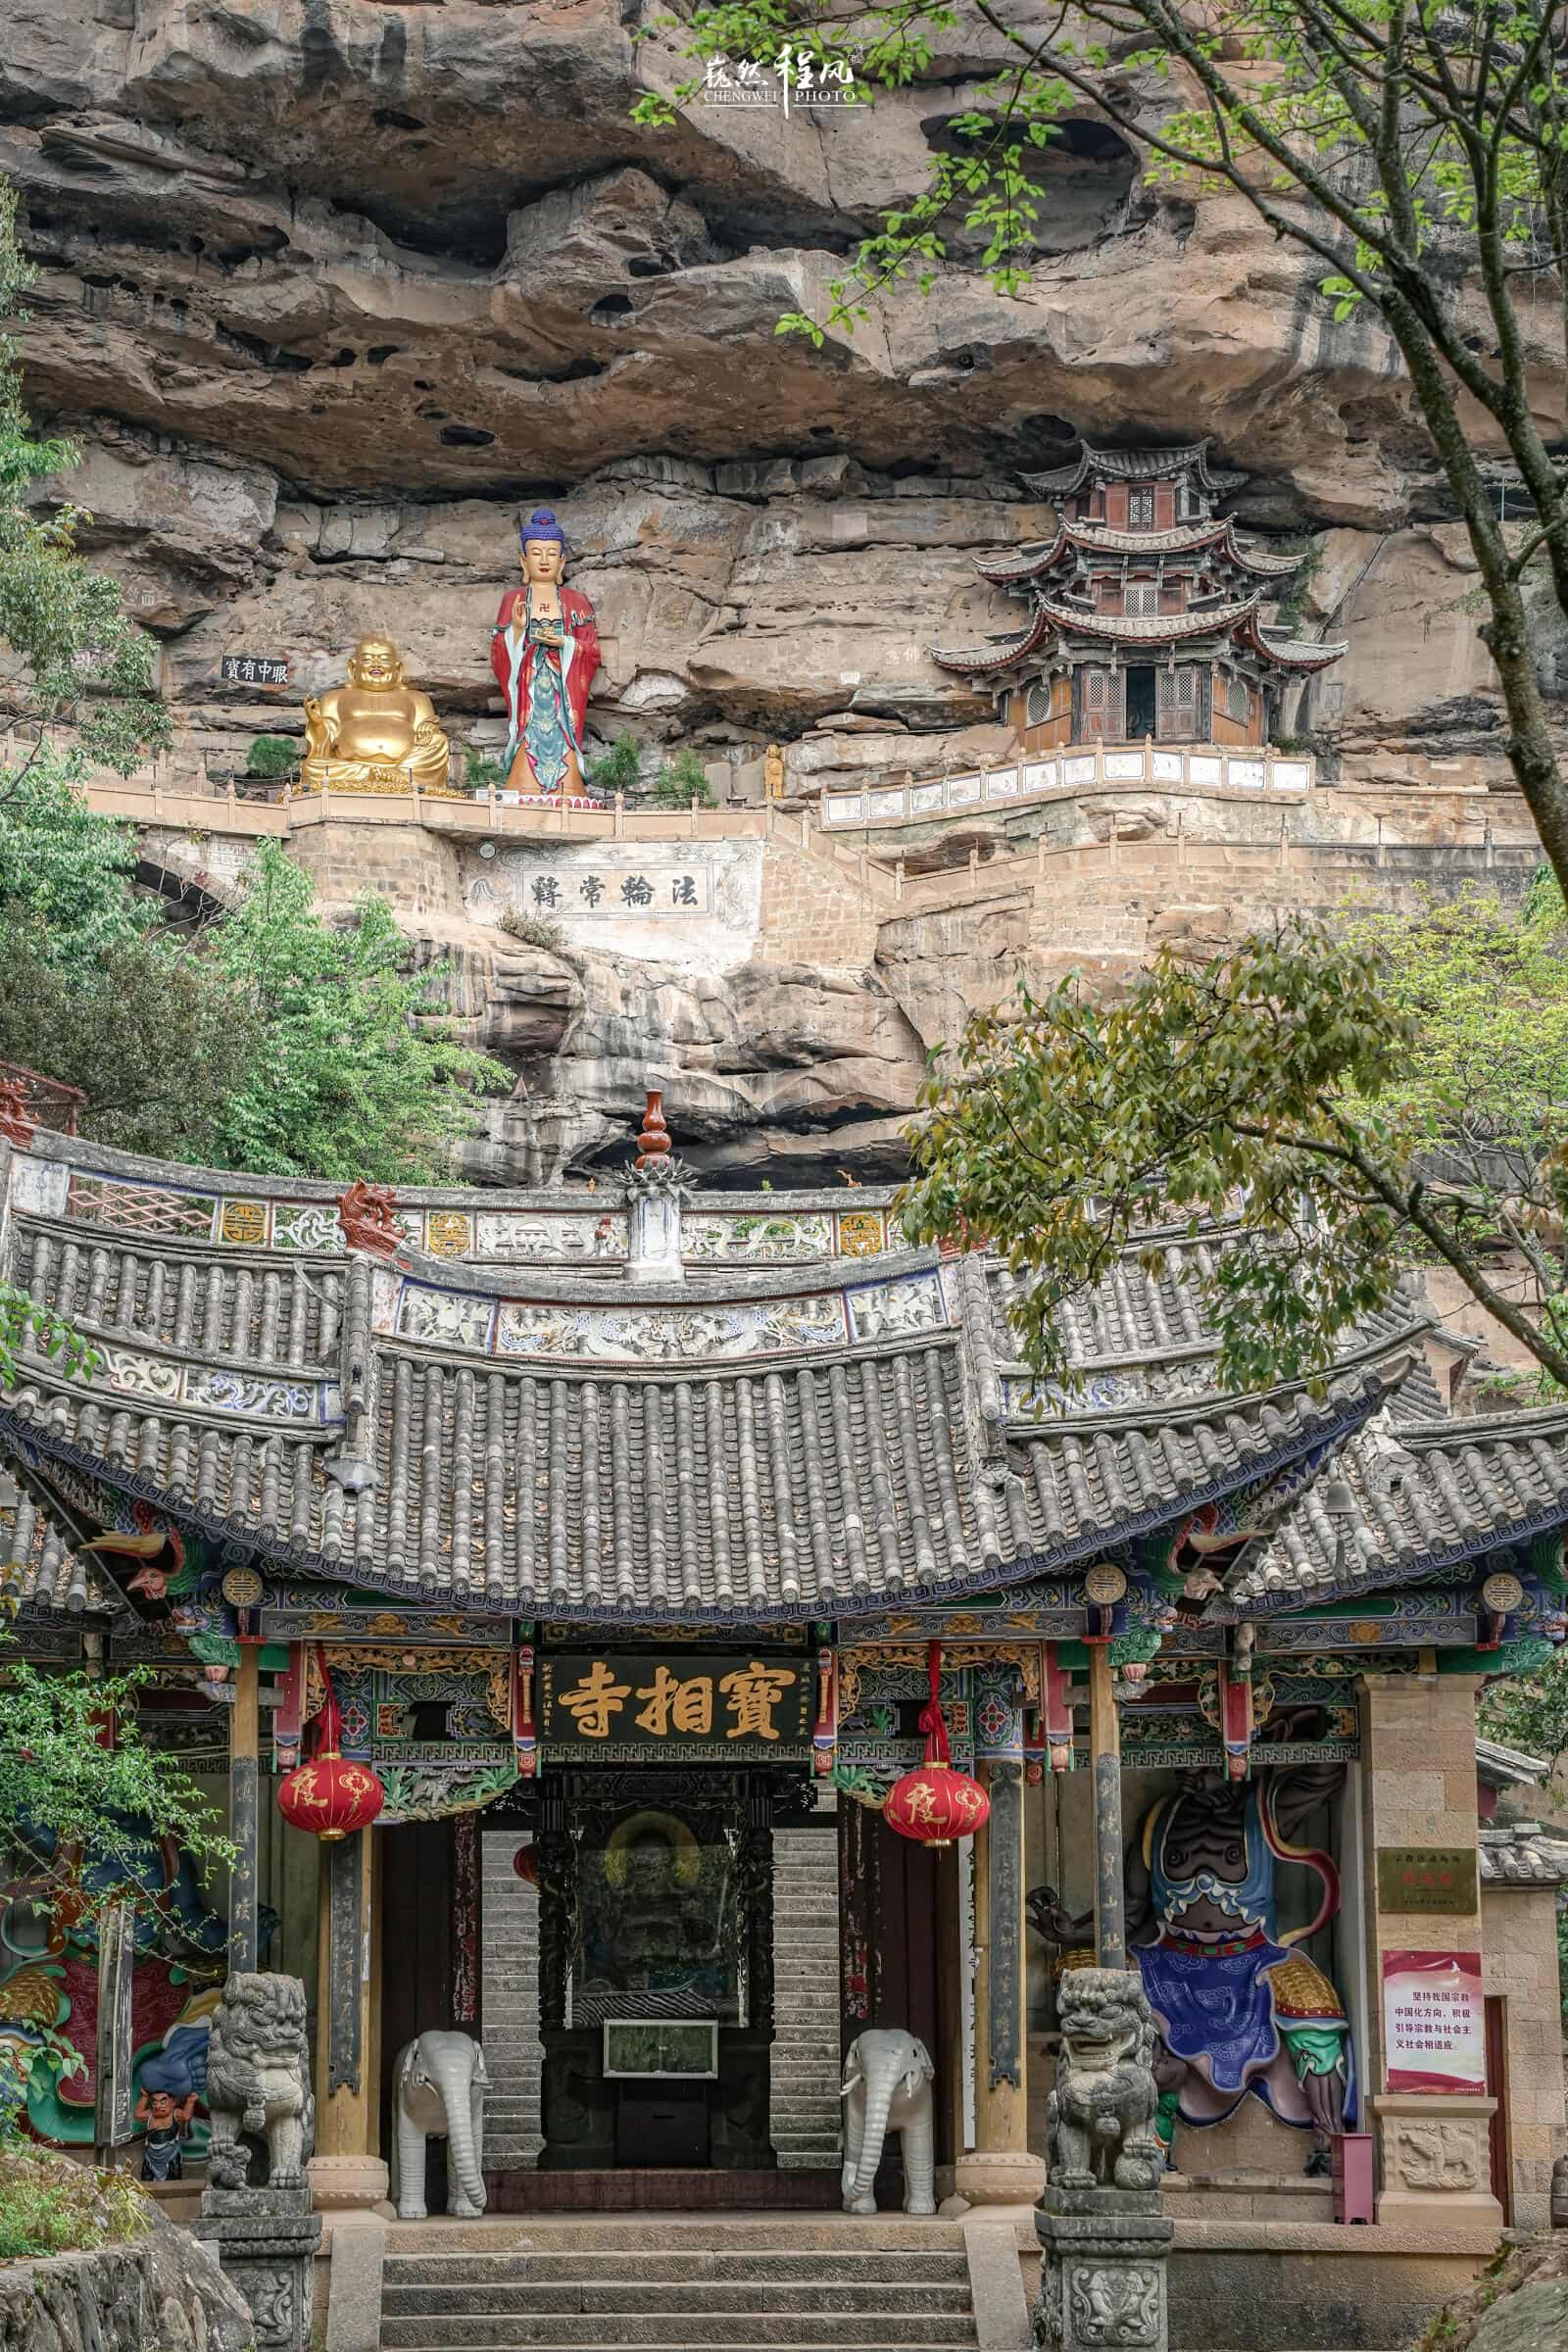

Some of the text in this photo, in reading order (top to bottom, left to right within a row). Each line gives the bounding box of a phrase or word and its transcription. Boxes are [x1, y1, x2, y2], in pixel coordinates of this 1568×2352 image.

[559, 1661, 796, 1740] 寶相寺
[1412, 1991, 1470, 2002] 坚持我国宗教
[1395, 2025, 1472, 2035] 引导宗教与社会主
